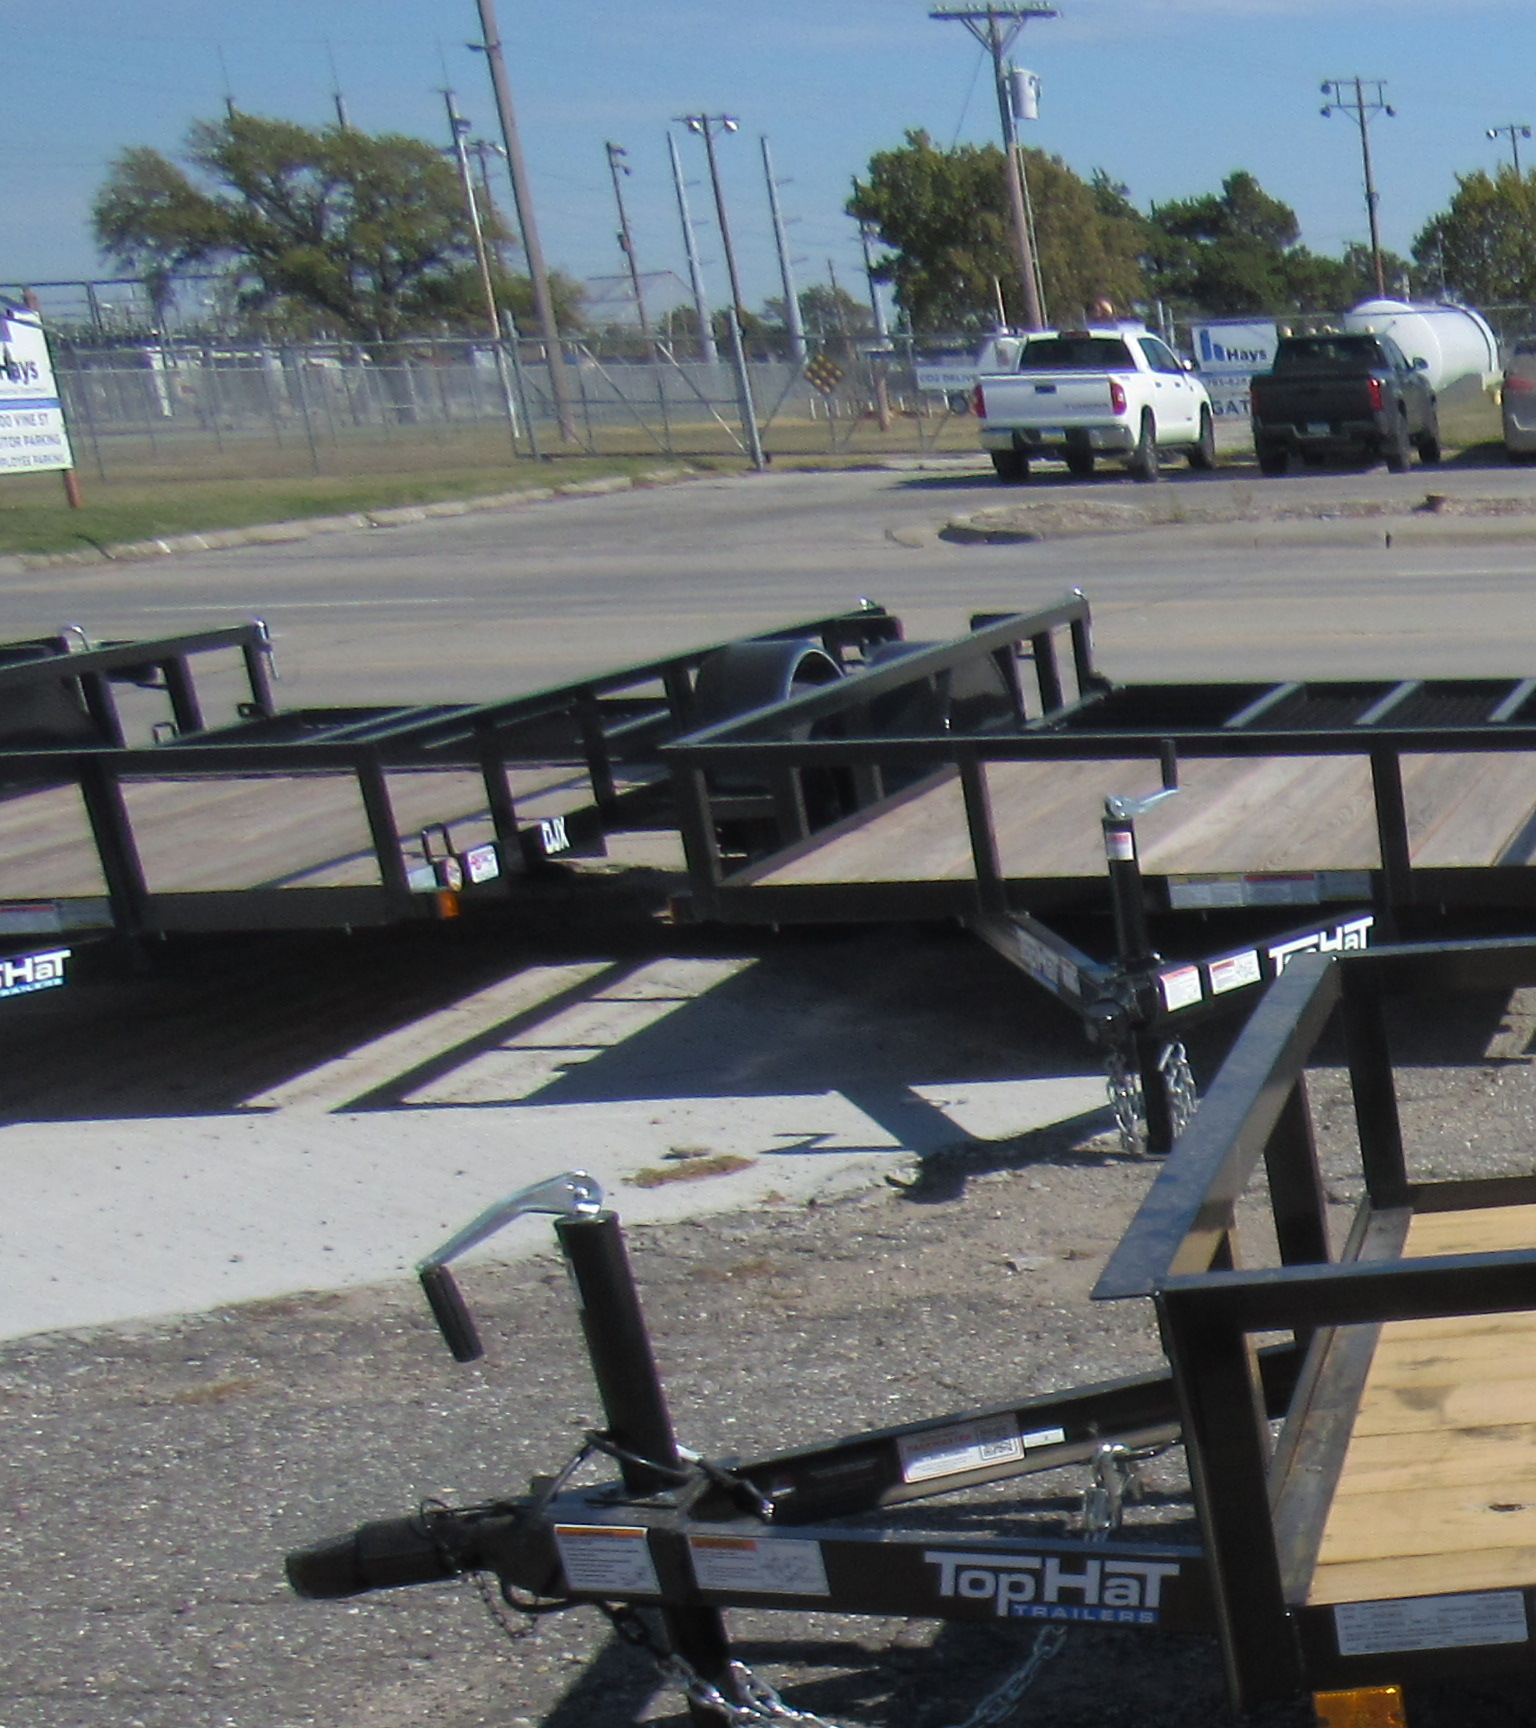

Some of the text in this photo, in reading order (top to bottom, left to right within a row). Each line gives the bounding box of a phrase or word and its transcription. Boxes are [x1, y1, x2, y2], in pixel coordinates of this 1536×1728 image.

[1226, 347, 1268, 362] Hays
[541, 816, 570, 854] DJX
[1012, 1604, 1155, 1623] TRAILERS
